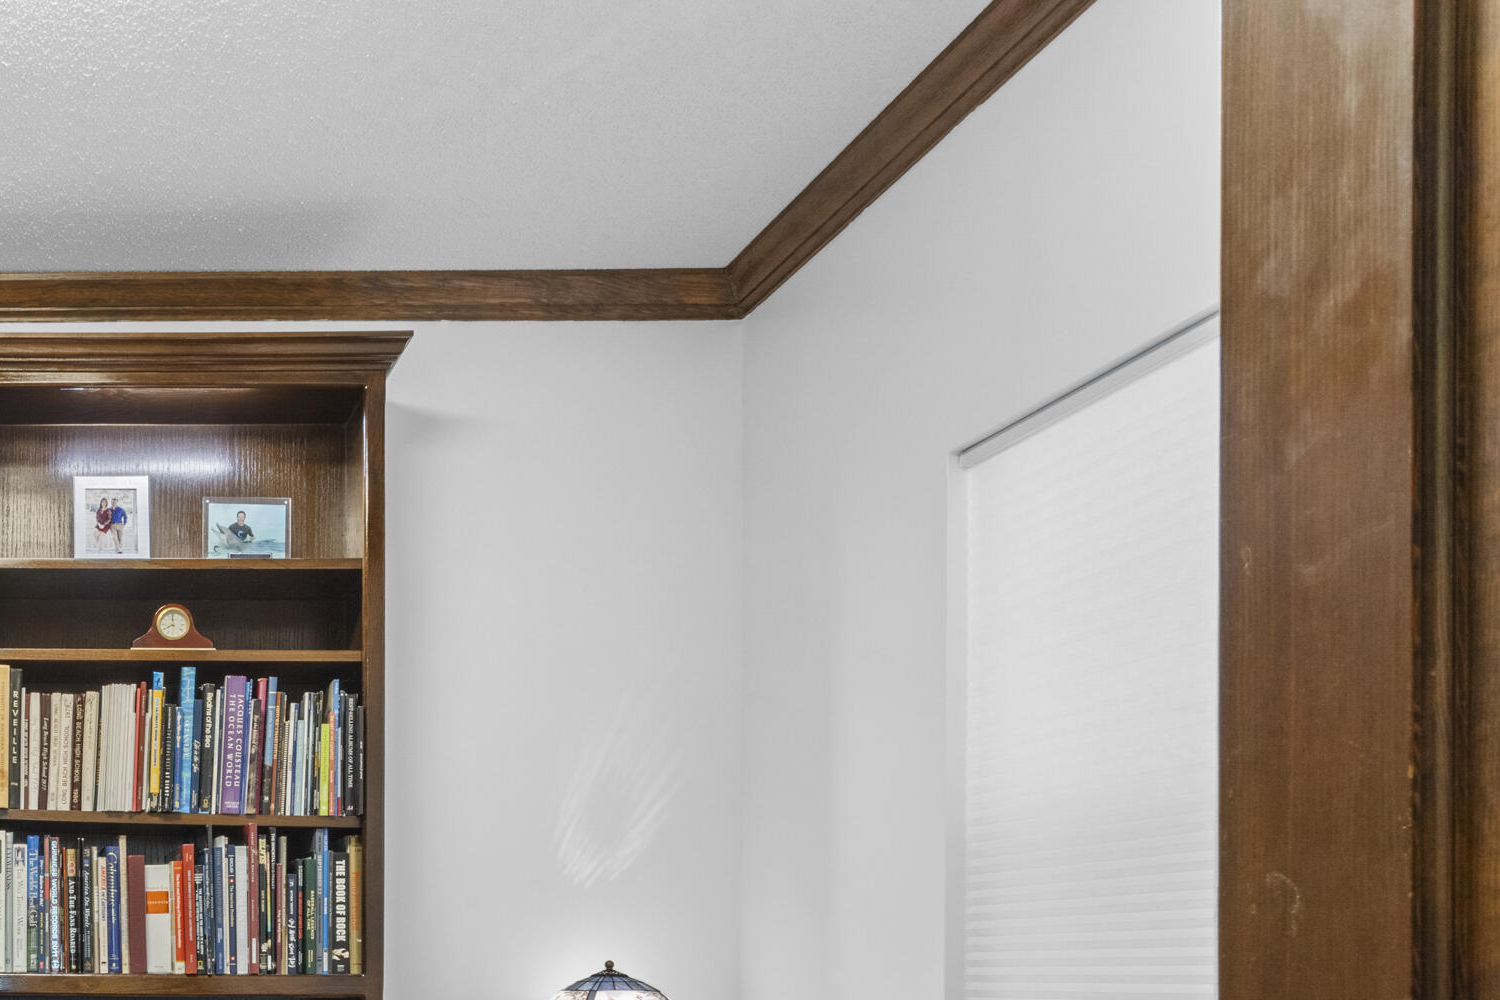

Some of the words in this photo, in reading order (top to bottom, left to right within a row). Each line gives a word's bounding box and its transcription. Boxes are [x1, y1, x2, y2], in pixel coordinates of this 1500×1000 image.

[236, 694, 244, 734] JACQUES
[227, 716, 235, 749] OCEAN
[225, 753, 233, 787] WORLD
[234, 738, 243, 787] COUSTEAU
[348, 754, 353, 763] OF
[107, 851, 117, 906] Columbus
[335, 860, 346, 877] THE
[336, 878, 346, 904] BOOK
[336, 905, 346, 916] OF
[336, 917, 346, 942] ROCK
